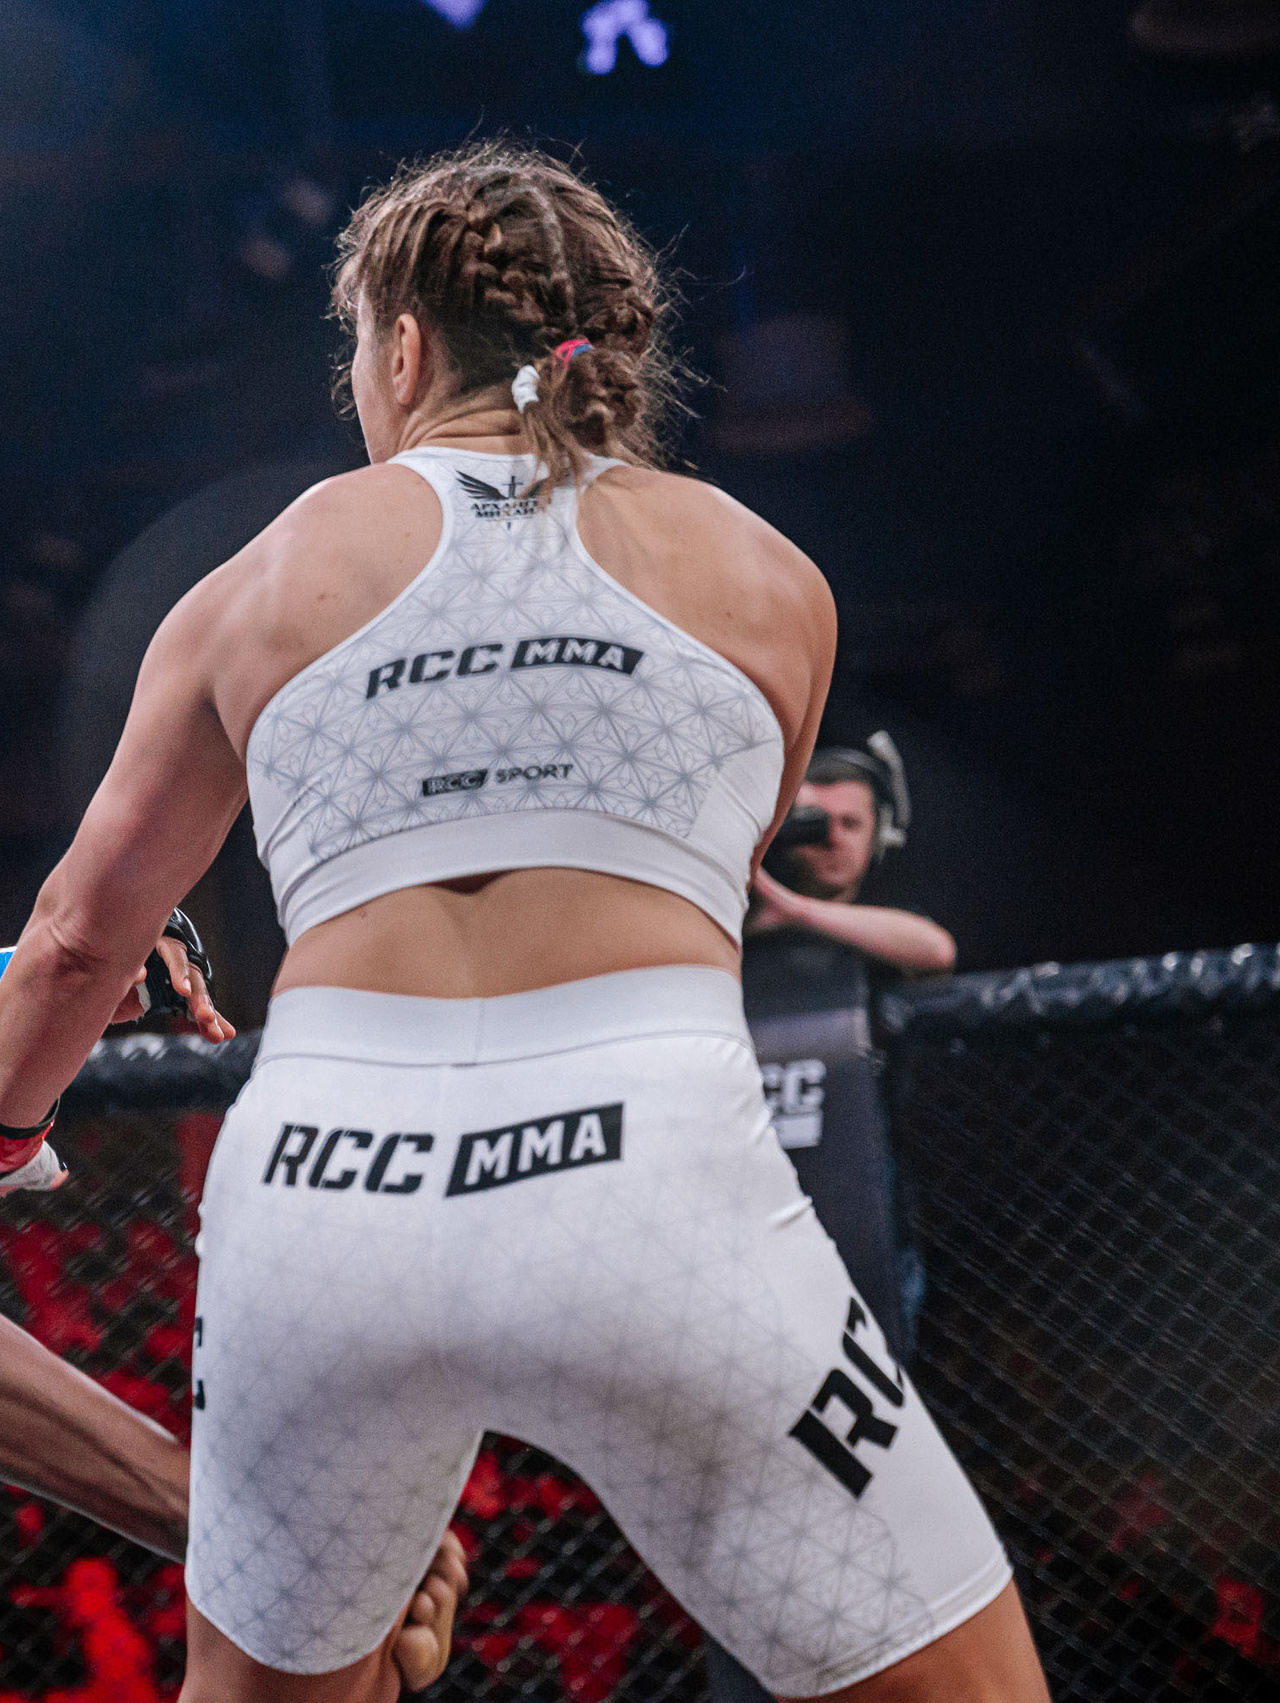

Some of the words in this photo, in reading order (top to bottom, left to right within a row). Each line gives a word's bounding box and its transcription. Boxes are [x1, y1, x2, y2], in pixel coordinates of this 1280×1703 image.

[366, 643, 503, 700] RCC
[523, 638, 625, 671] MMA
[427, 771, 484, 794] RCC
[495, 764, 574, 785] SPORT
[264, 1123, 434, 1194] RCC
[464, 1113, 607, 1186] MMA
